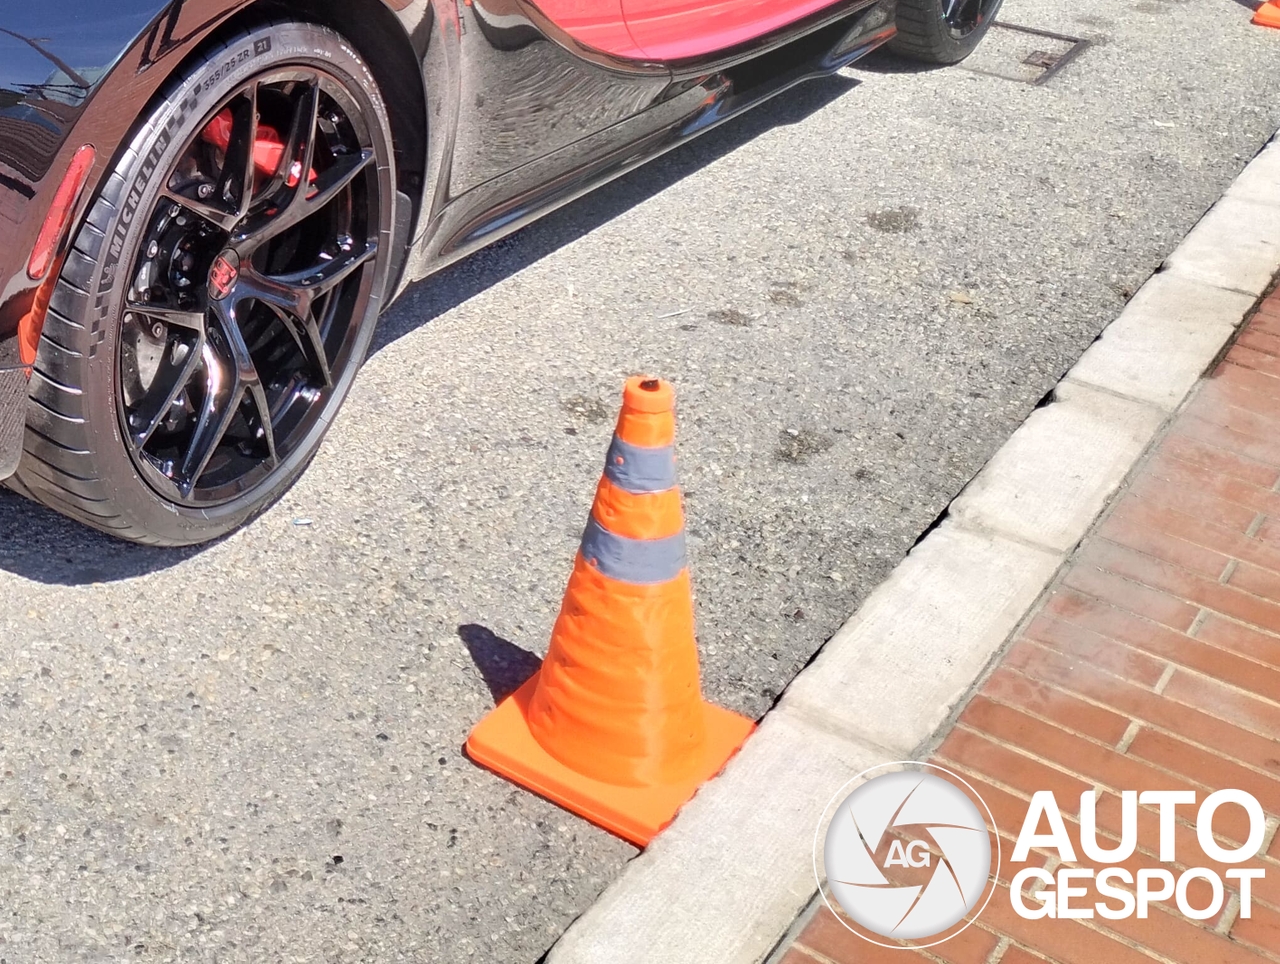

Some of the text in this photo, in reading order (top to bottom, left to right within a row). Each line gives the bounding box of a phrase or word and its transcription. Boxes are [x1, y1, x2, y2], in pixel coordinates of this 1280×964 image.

[237, 49, 250, 62] ZR
[257, 40, 267, 52] 21
[109, 138, 168, 259] MICHELIN
